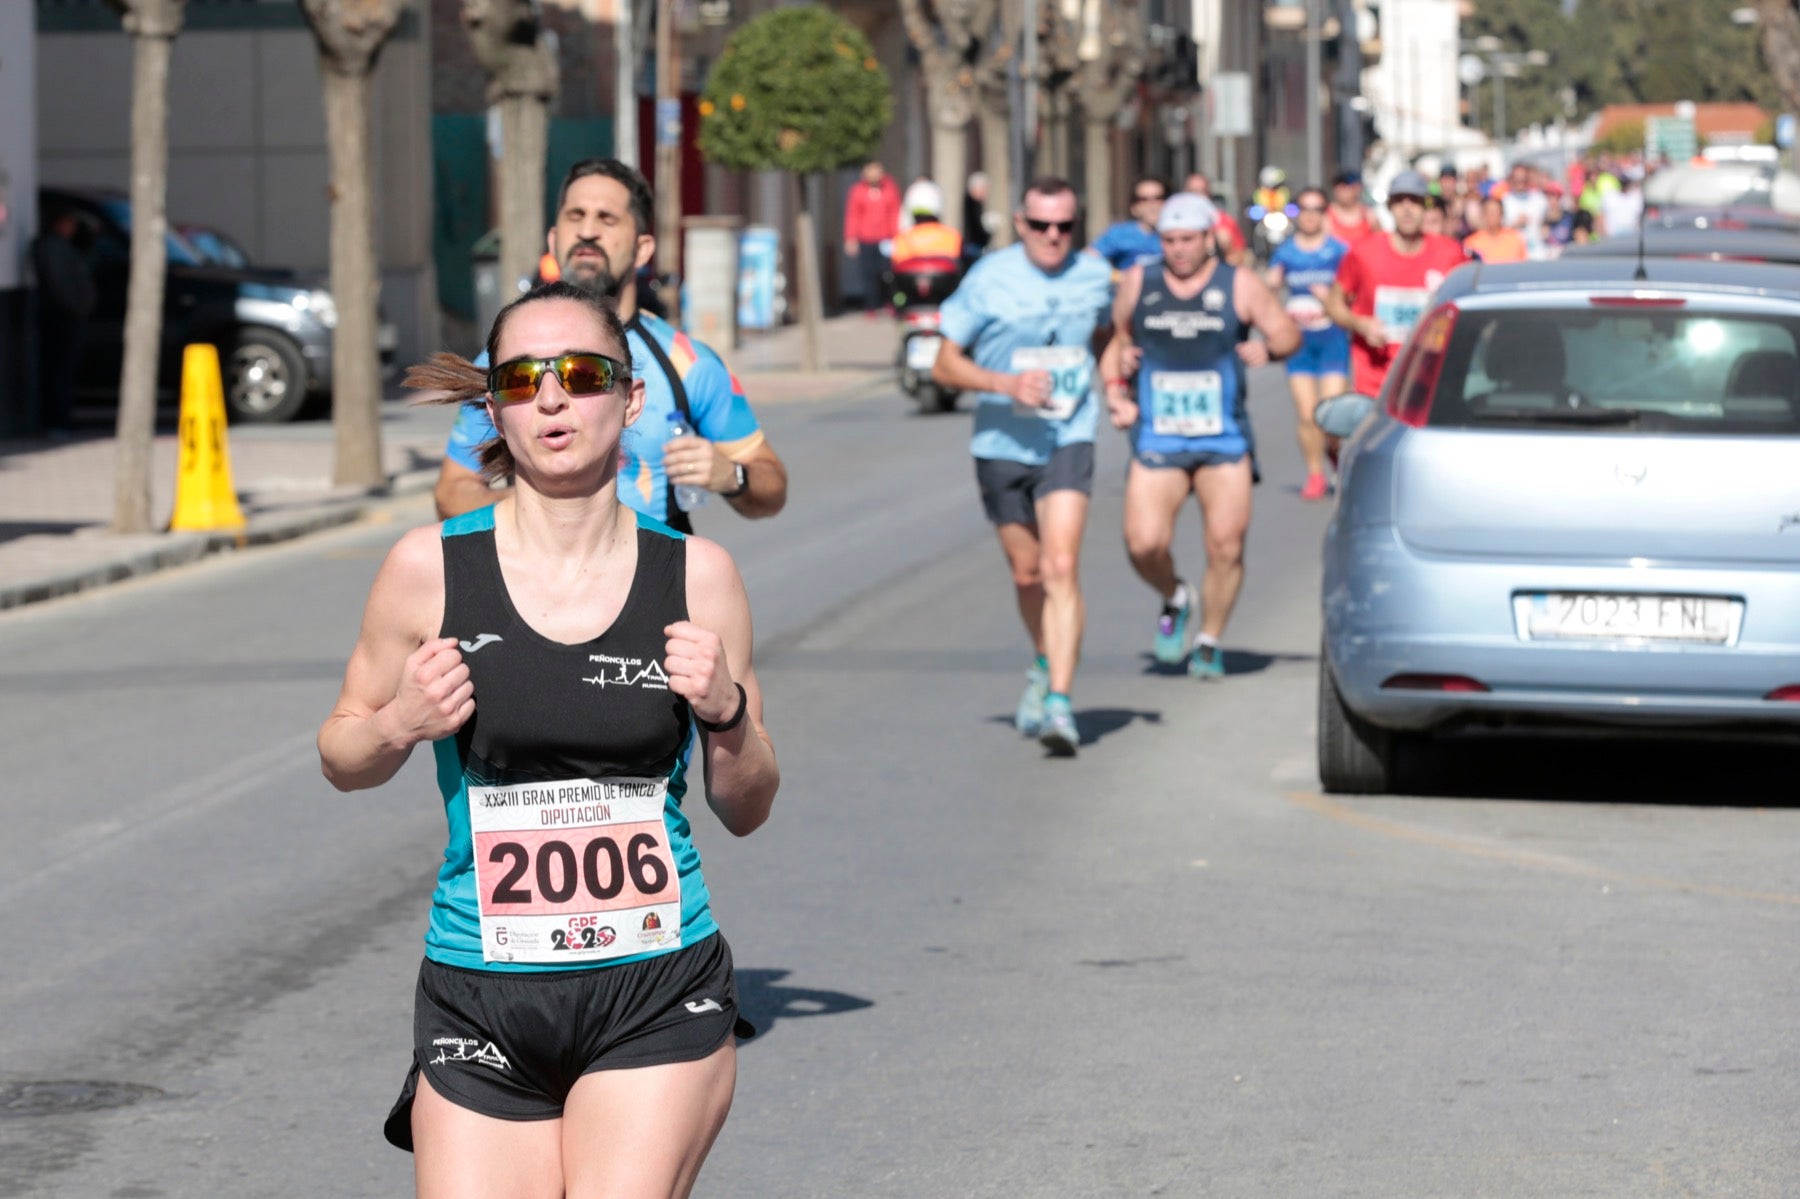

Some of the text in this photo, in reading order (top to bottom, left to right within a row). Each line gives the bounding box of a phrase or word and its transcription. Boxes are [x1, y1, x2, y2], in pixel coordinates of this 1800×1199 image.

[1162, 392, 1209, 415] 214
[1657, 597, 1719, 631] FNL
[589, 654, 641, 666] PEÑONCILLOS
[484, 791, 518, 808] XXXIII
[522, 789, 555, 806] GRAN
[558, 784, 601, 804] PREMIO
[603, 783, 616, 800] DE
[541, 803, 611, 825] DIPUTACIÓN
[489, 833, 669, 904] 2006
[432, 1037, 479, 1046] PEÑONCILLOS
